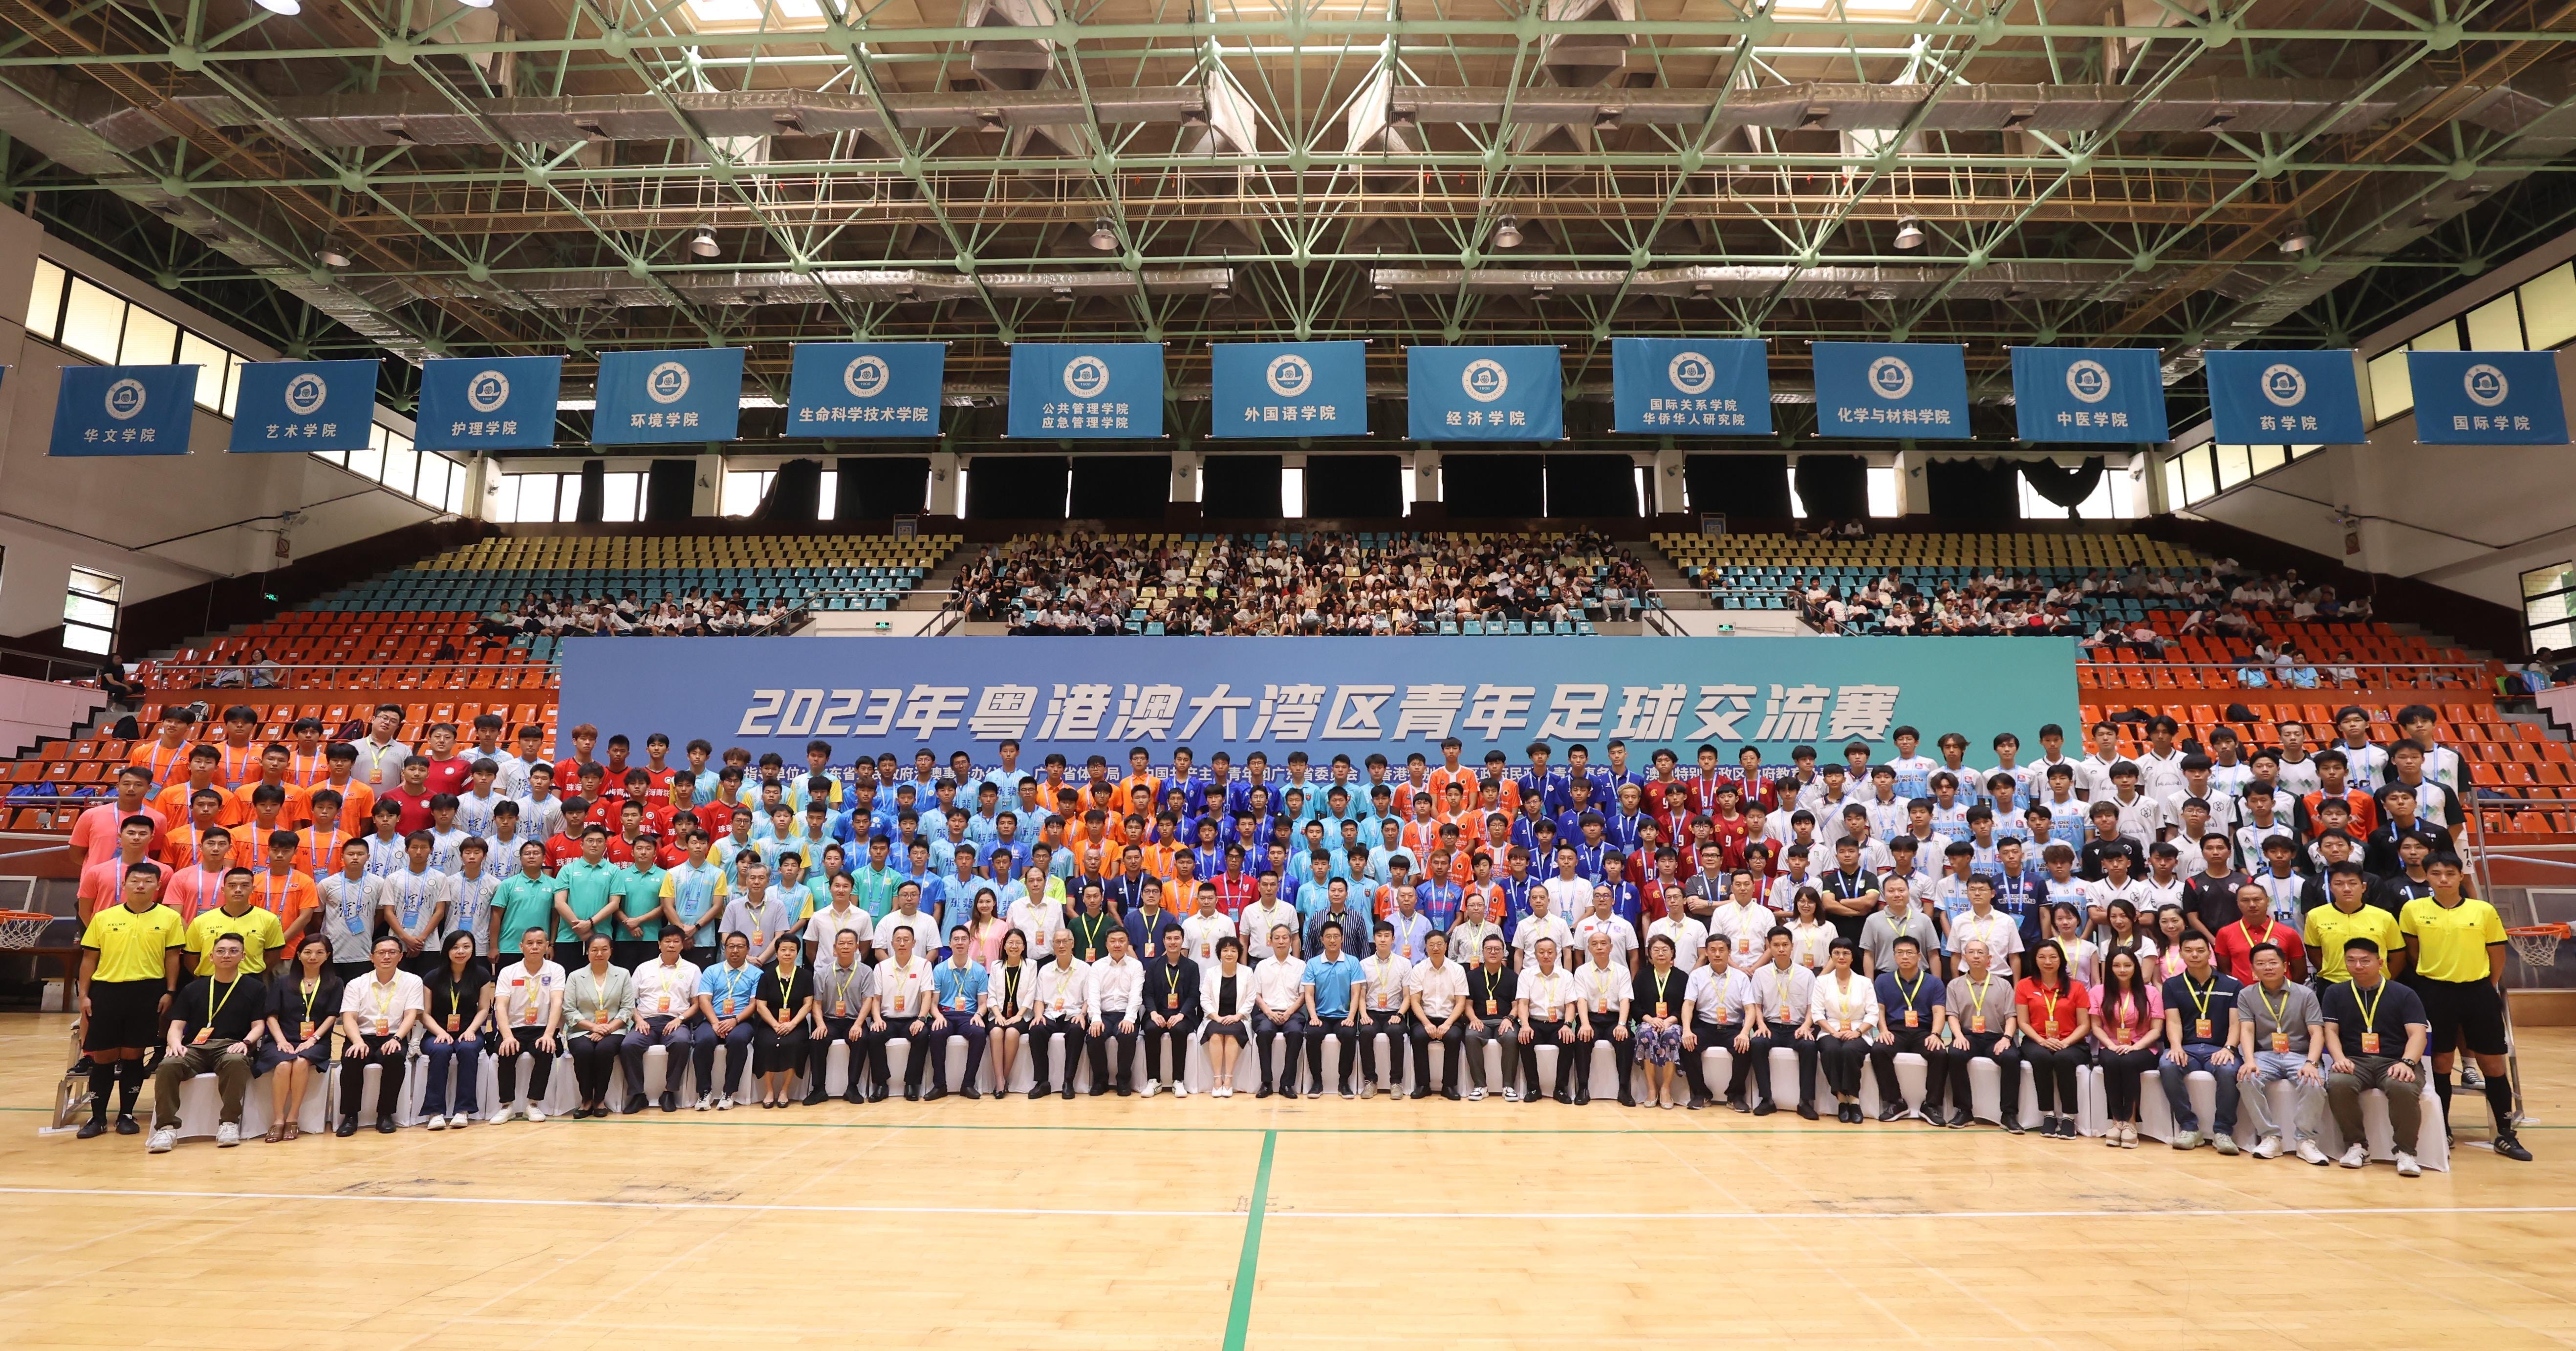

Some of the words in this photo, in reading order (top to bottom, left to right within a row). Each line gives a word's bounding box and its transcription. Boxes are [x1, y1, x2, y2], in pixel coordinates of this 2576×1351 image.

[1043, 403, 1128, 414] 公共管理学院
[1651, 399, 1737, 411] 国际关系学院
[631, 412, 698, 428] 环境学院
[799, 407, 928, 422] 生命科学技术学院
[1245, 405, 1336, 422] 外国语学院
[1447, 410, 1525, 426] 经济学院
[1644, 412, 1745, 426] 华侨华人研究院
[1838, 407, 1950, 424] 化学与材料学院
[2058, 411, 2128, 427] 中医学院
[452, 421, 517, 435] 护理学院
[1042, 416, 1128, 429] 应急管理学院
[2260, 416, 2317, 430] 药学院
[2454, 416, 2530, 430] 国际学院
[85, 429, 154, 442] 华文学院
[267, 423, 336, 438] 艺术学院
[734, 683, 1899, 741] 2023年粤港澳大湾区青年足球交流赛
[1034, 767, 1119, 781] 广省体局
[1663, 797, 1668, 809] 9
[1679, 835, 1684, 846] 9
[1726, 835, 1732, 847] 9
[2464, 849, 2468, 858] 7
[1648, 868, 1653, 880] 9
[339, 901, 369, 917] 深圳
[951, 898, 973, 907] 东莞
